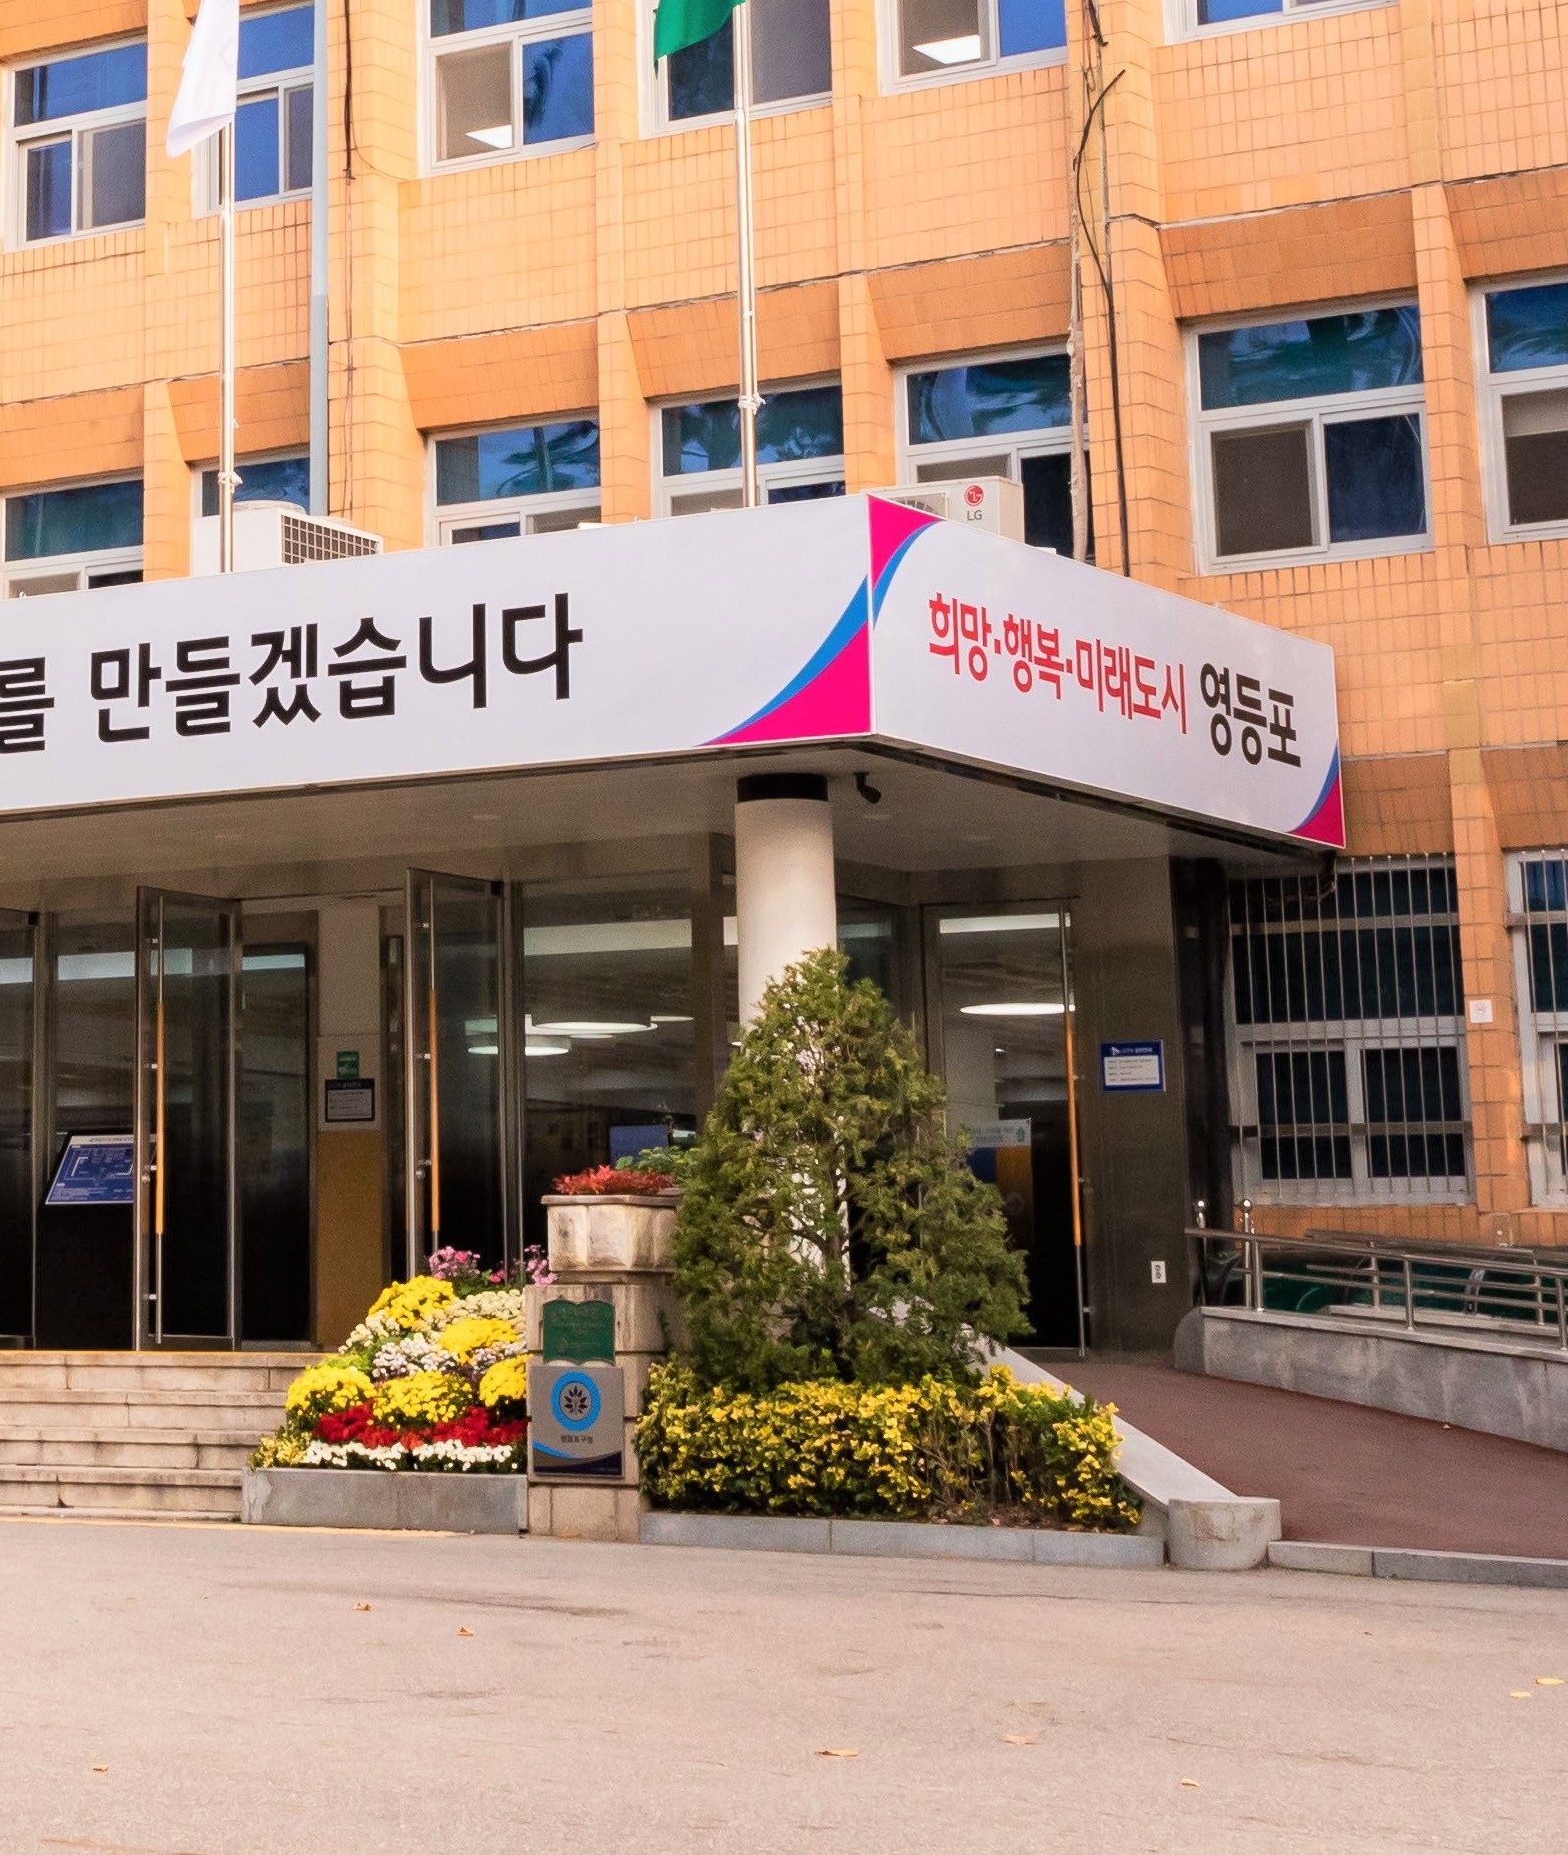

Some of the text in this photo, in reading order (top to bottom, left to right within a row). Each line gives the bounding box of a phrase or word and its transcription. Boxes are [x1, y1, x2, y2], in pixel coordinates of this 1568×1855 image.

[967, 510, 982, 521] LG
[90, 592, 584, 744] 만들겠습니다
[1200, 662, 1302, 768] 영등포
